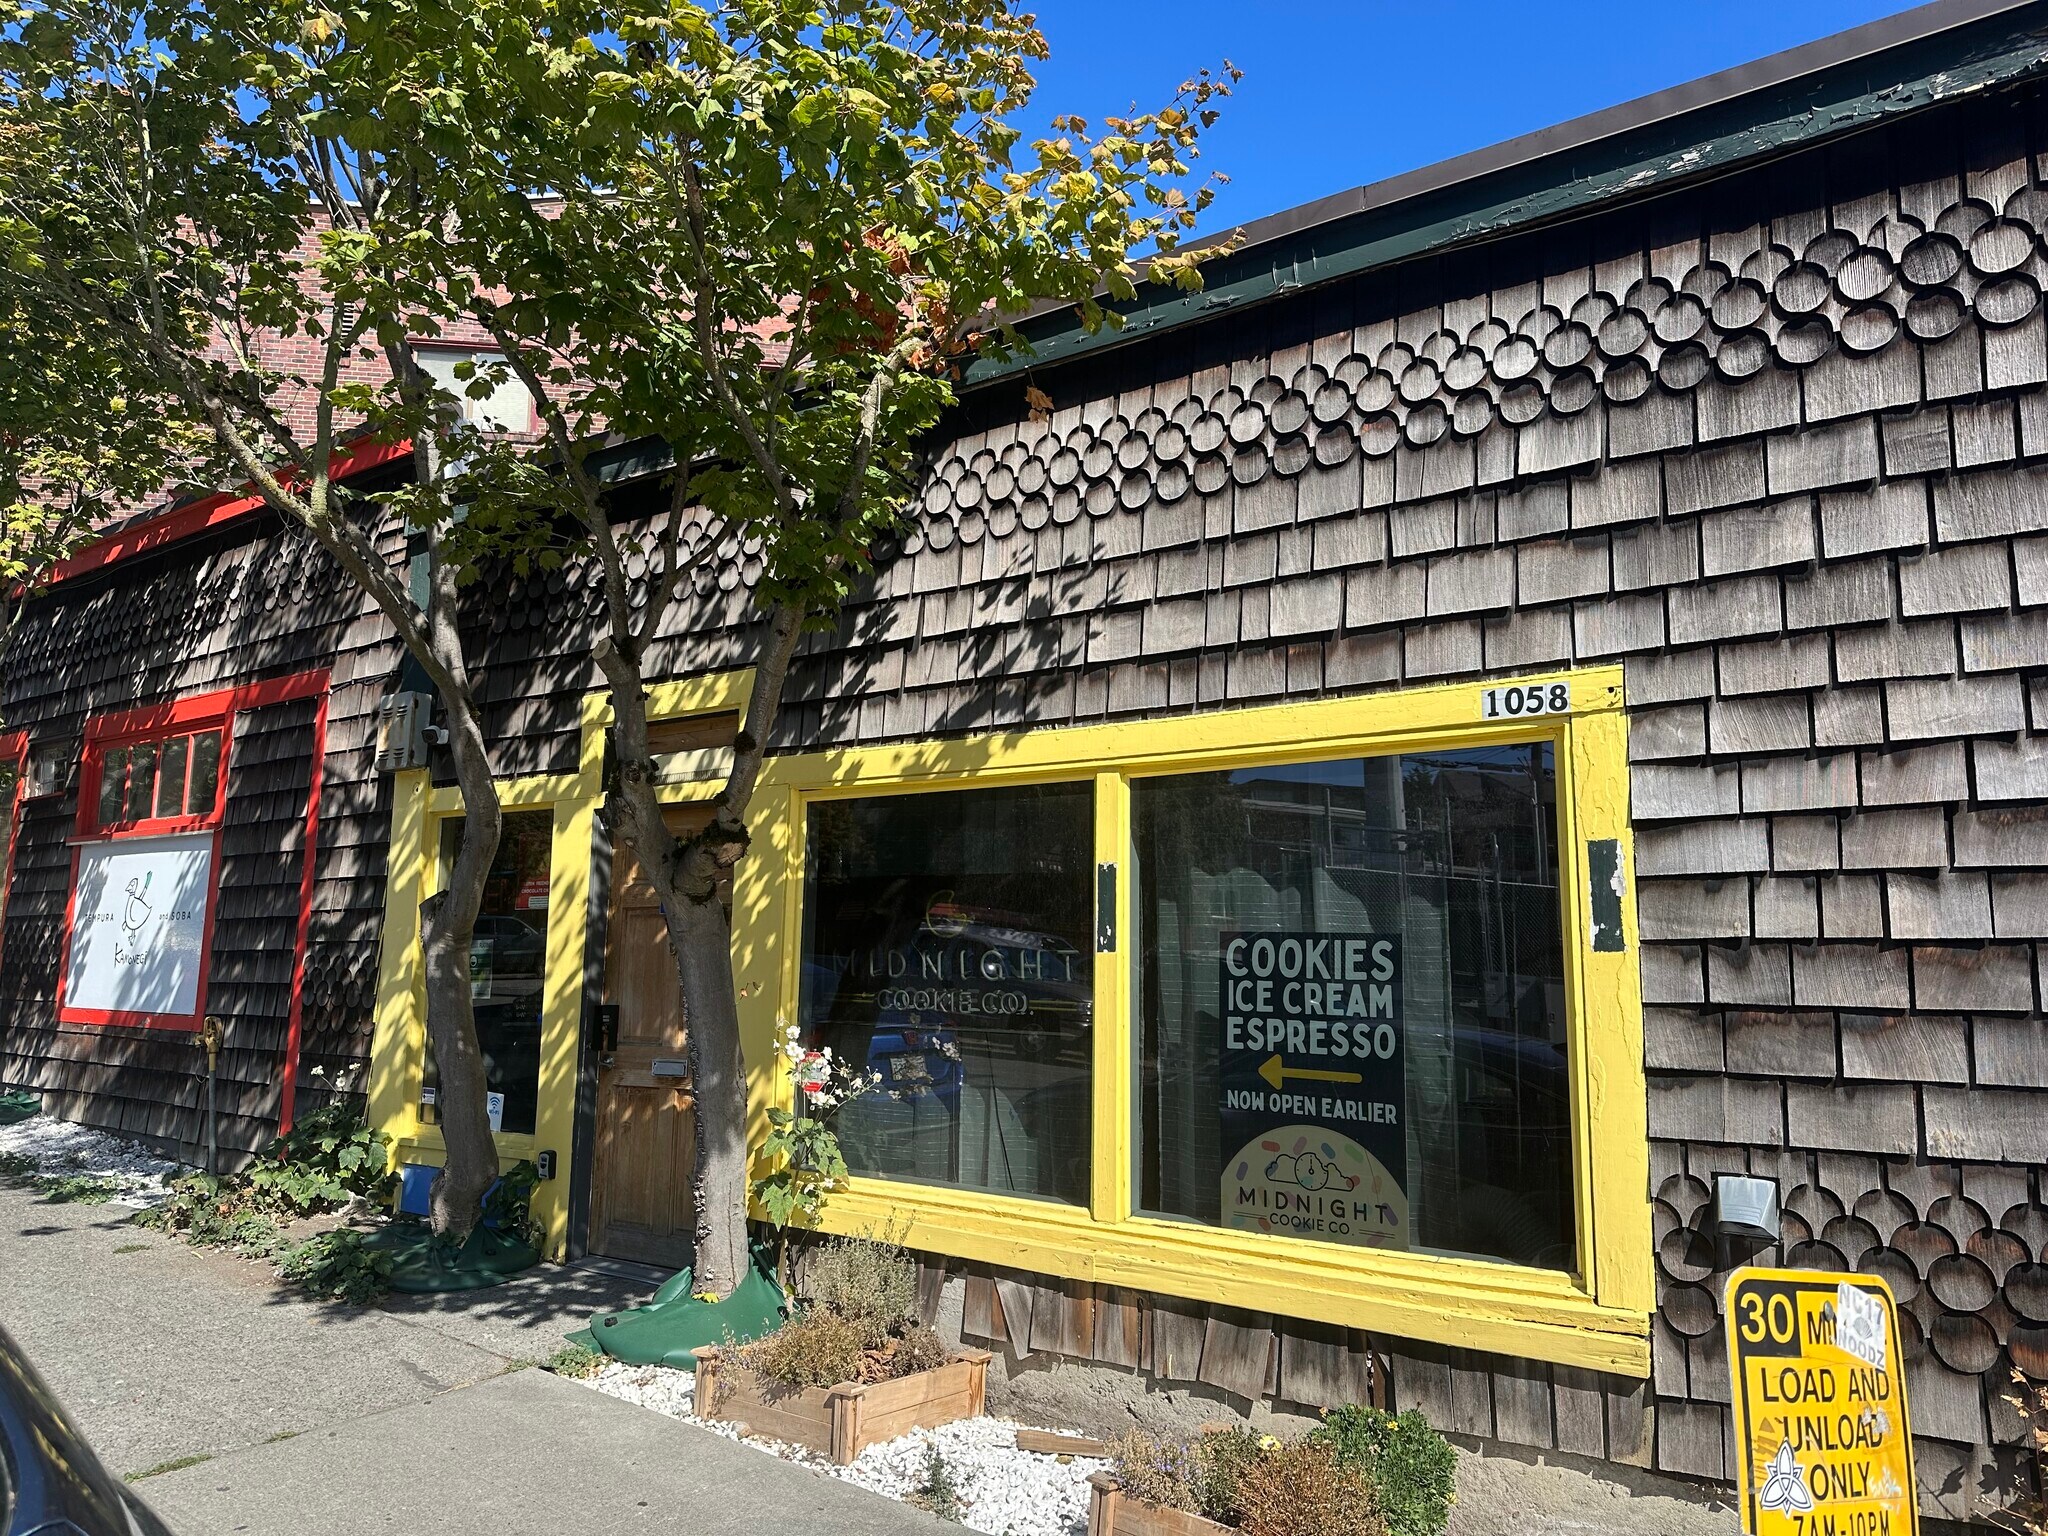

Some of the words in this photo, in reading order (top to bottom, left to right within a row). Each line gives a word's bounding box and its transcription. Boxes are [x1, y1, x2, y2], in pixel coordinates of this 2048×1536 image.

[1487, 684, 1568, 717] 1058
[84, 913, 114, 922] TEMPURA
[170, 911, 192, 921] SOBA
[832, 949, 1079, 983] MIDNIGHT
[1226, 938, 1395, 981] COOKIES
[877, 987, 973, 1014] COOKIE
[1228, 980, 1274, 1013] ICE
[1282, 982, 1394, 1019] CREAM
[1226, 1016, 1396, 1059] ESPRESSO
[1227, 1089, 1265, 1112] NOW
[1269, 1093, 1316, 1117] OPEN
[1321, 1097, 1398, 1125] EARLIER
[1239, 1186, 1388, 1224] MIDNIGHT
[1269, 1213, 1325, 1232] COOKIE
[1328, 1221, 1355, 1236] CO.
[1740, 1292, 1795, 1344] 30
[1839, 1282, 1884, 1326] NC17
[1838, 1328, 1885, 1369] NOODZ
[1761, 1367, 1836, 1404] LOAD
[1848, 1368, 1890, 1403] AND
[1783, 1414, 1883, 1452] UNLOAD
[1810, 1461, 1870, 1501] ONLY
